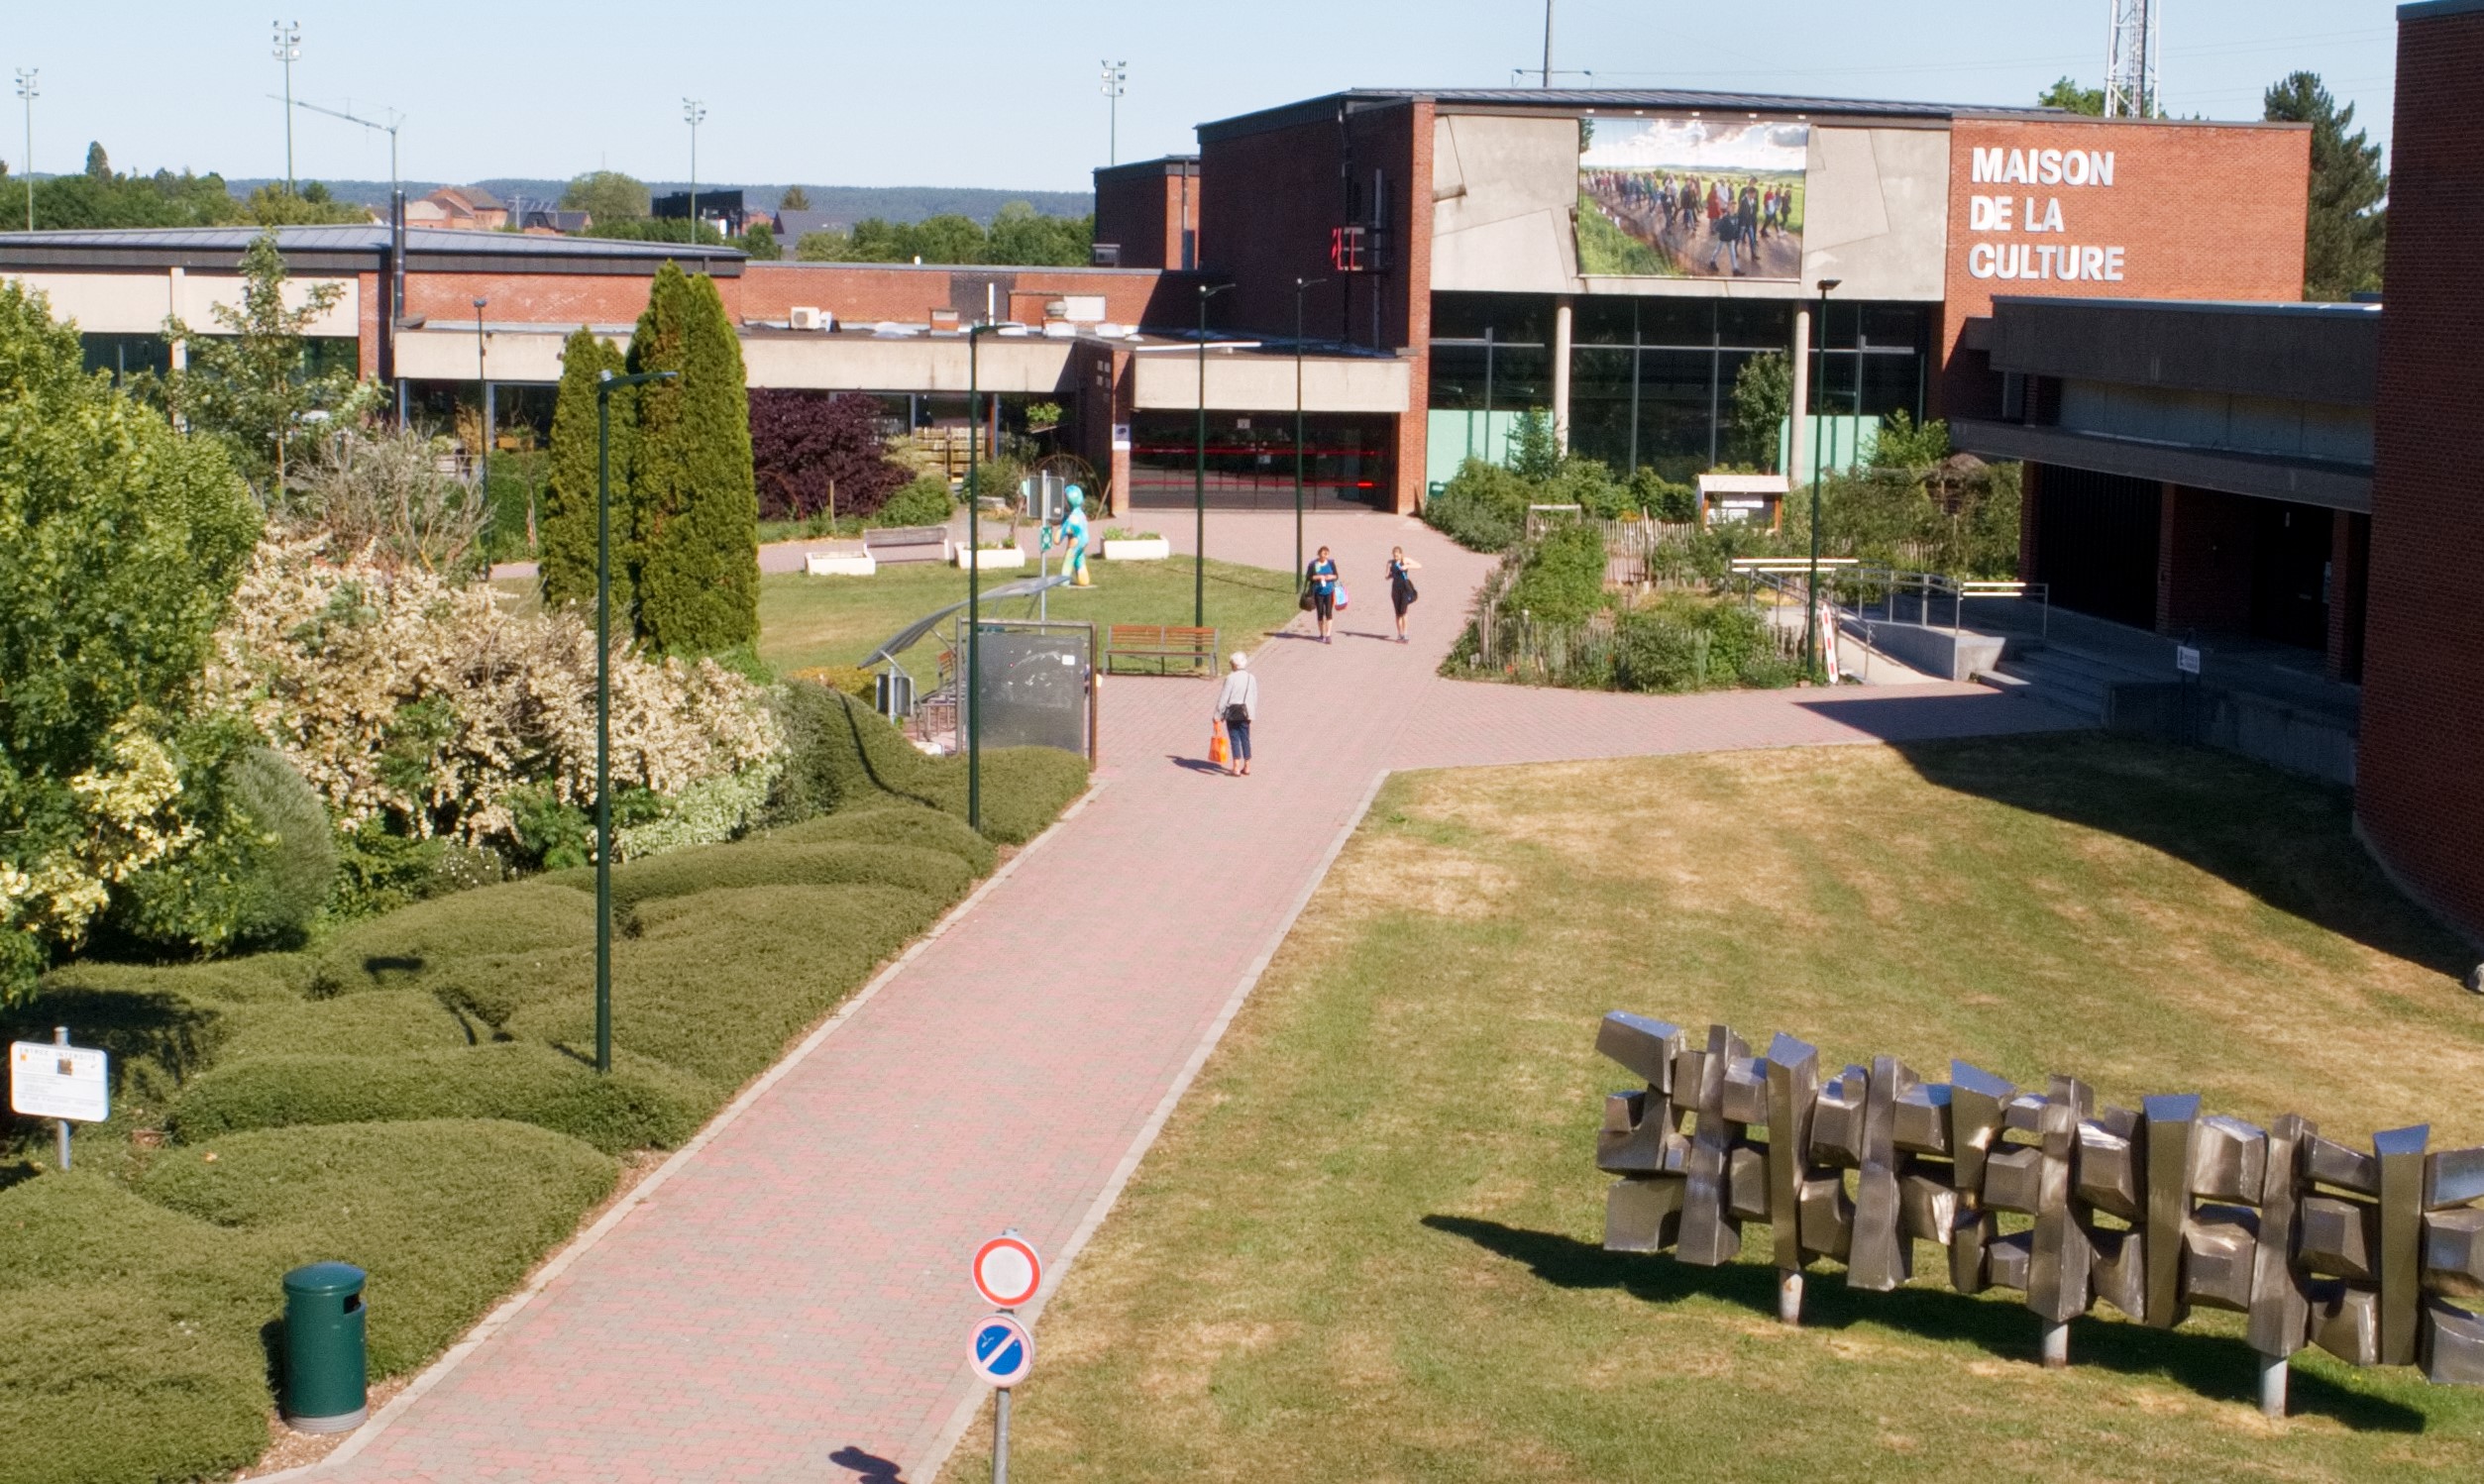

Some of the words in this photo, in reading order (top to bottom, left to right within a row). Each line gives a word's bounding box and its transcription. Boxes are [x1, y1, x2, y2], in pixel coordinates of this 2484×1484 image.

[1971, 147, 2115, 186] MAISON
[1970, 195, 2013, 231] DE
[2024, 196, 2065, 233] LA
[1968, 243, 2125, 281] CULTURE
